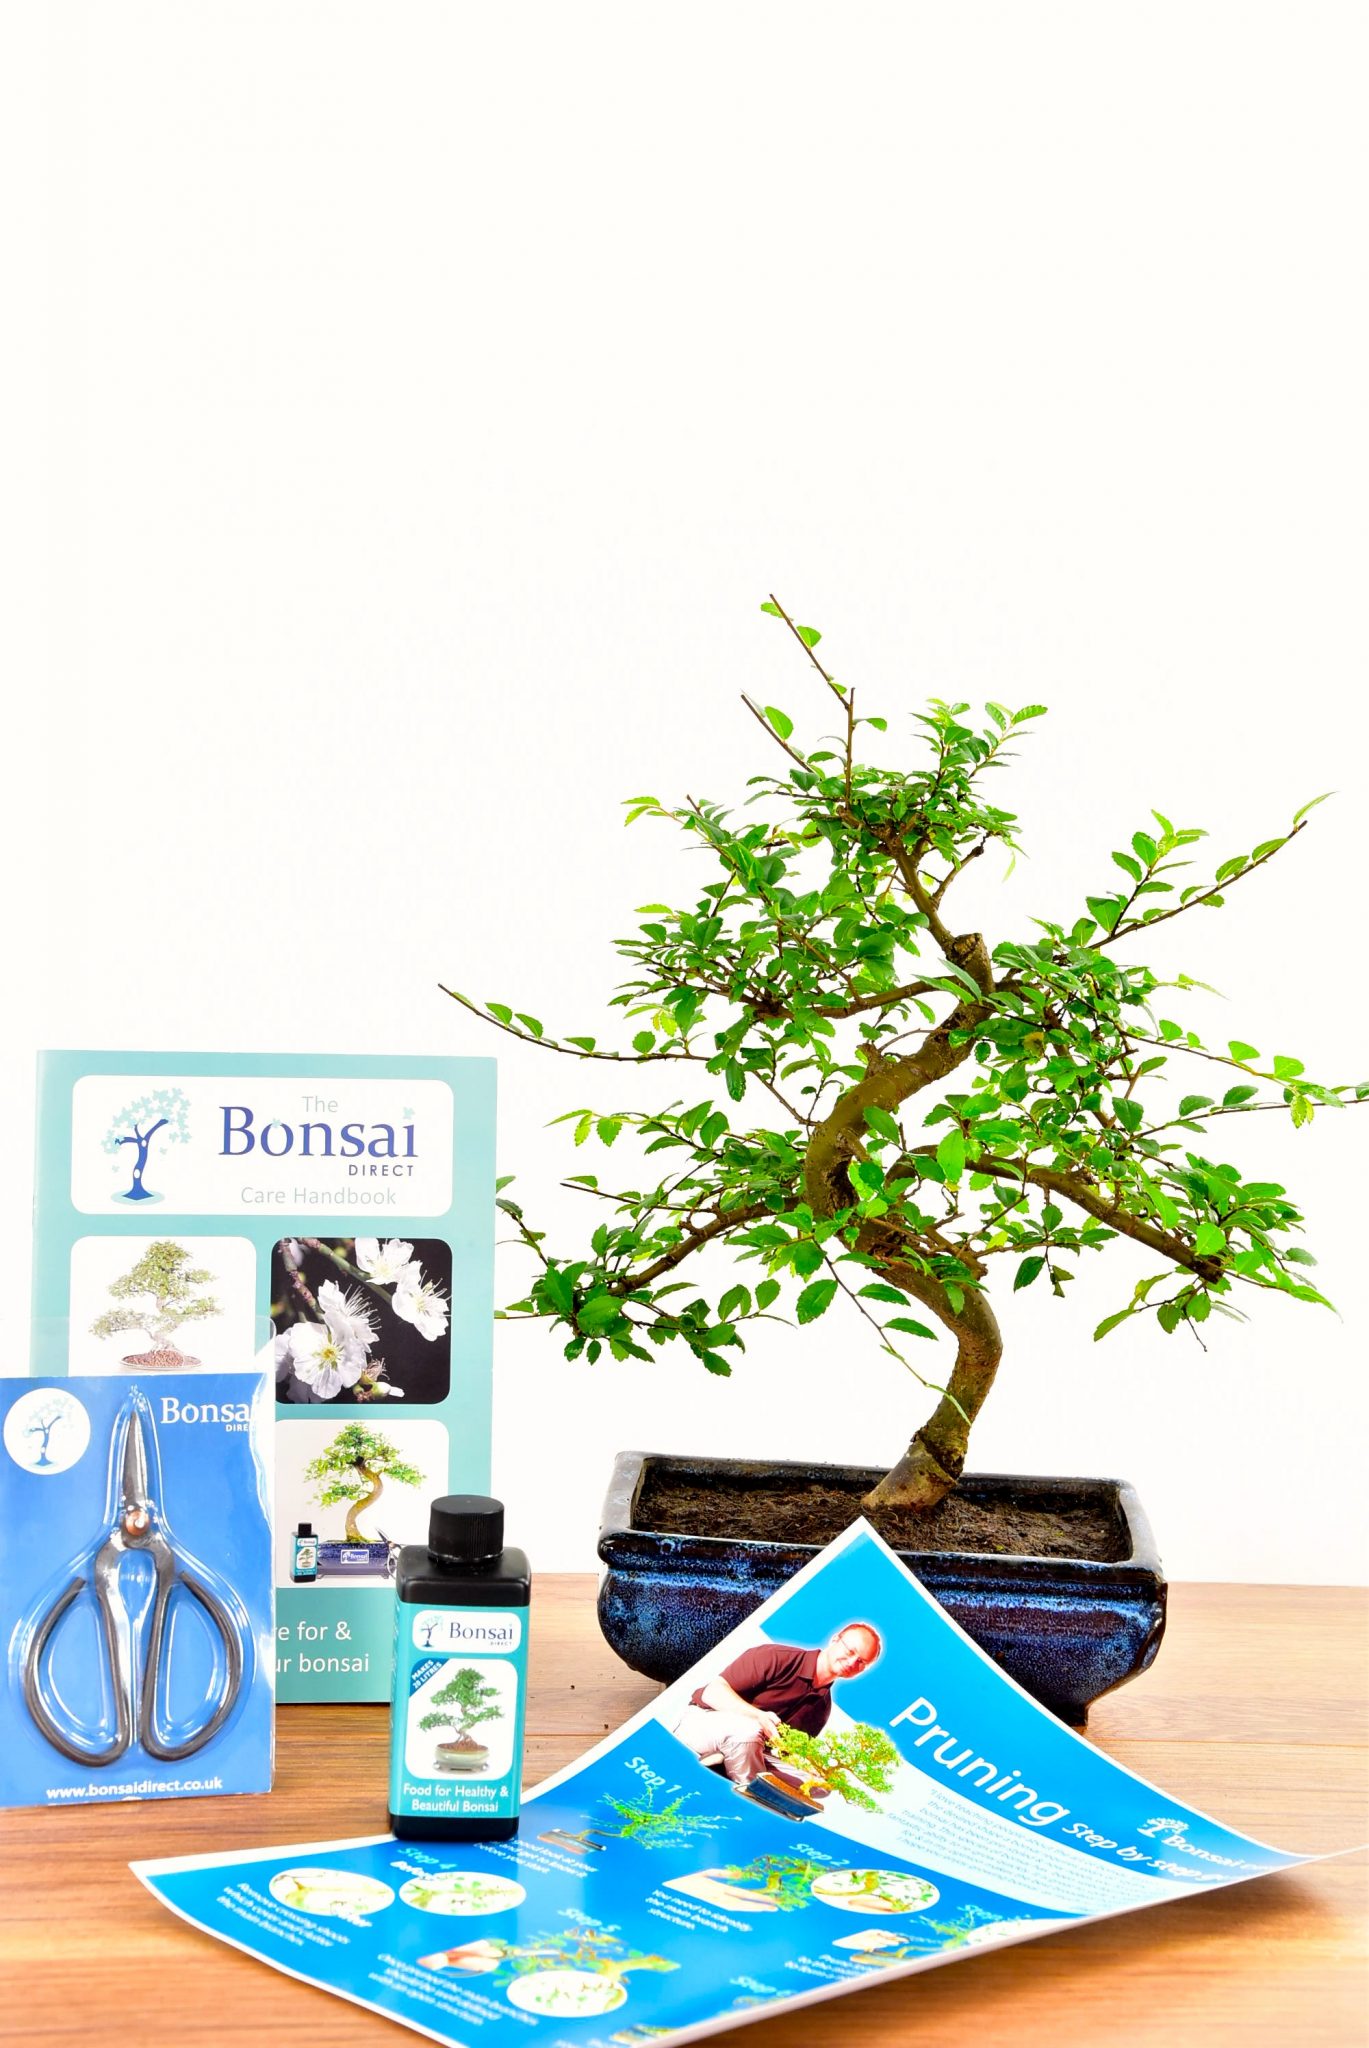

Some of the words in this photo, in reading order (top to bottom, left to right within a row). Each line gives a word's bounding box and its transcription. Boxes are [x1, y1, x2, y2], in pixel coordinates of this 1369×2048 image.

[302, 1095, 339, 1113] The
[218, 1105, 419, 1158] Bonsai
[348, 1164, 414, 1177] DIRECT
[241, 1186, 286, 1205] Care
[294, 1186, 396, 1206] Handbook
[160, 1396, 251, 1424] Bonsa
[225, 1423, 250, 1432] DIRE
[297, 1620, 328, 1641] for
[335, 1620, 352, 1641] &
[449, 1621, 514, 1640] Bonsai
[299, 1653, 370, 1673] bonsai
[411, 1659, 435, 1681] MAKES
[420, 1661, 443, 1683] LITRES
[624, 1755, 666, 1788] Step
[666, 1784, 682, 1794] 1
[889, 1696, 1071, 1827] Pruning
[1061, 1822, 1119, 1850] Step
[1116, 1845, 1153, 1862] by
[46, 1776, 223, 1799] www.bonsaidirect.co.uk
[403, 1782, 432, 1796] Food
[435, 1784, 452, 1797] for
[455, 1785, 497, 1801] Healthy
[499, 1785, 510, 1798] &
[411, 1798, 460, 1813] Beautiful
[462, 1800, 499, 1813] Bonsai
[789, 1843, 832, 1861] Step
[1161, 1833, 1242, 1868] Bonsai
